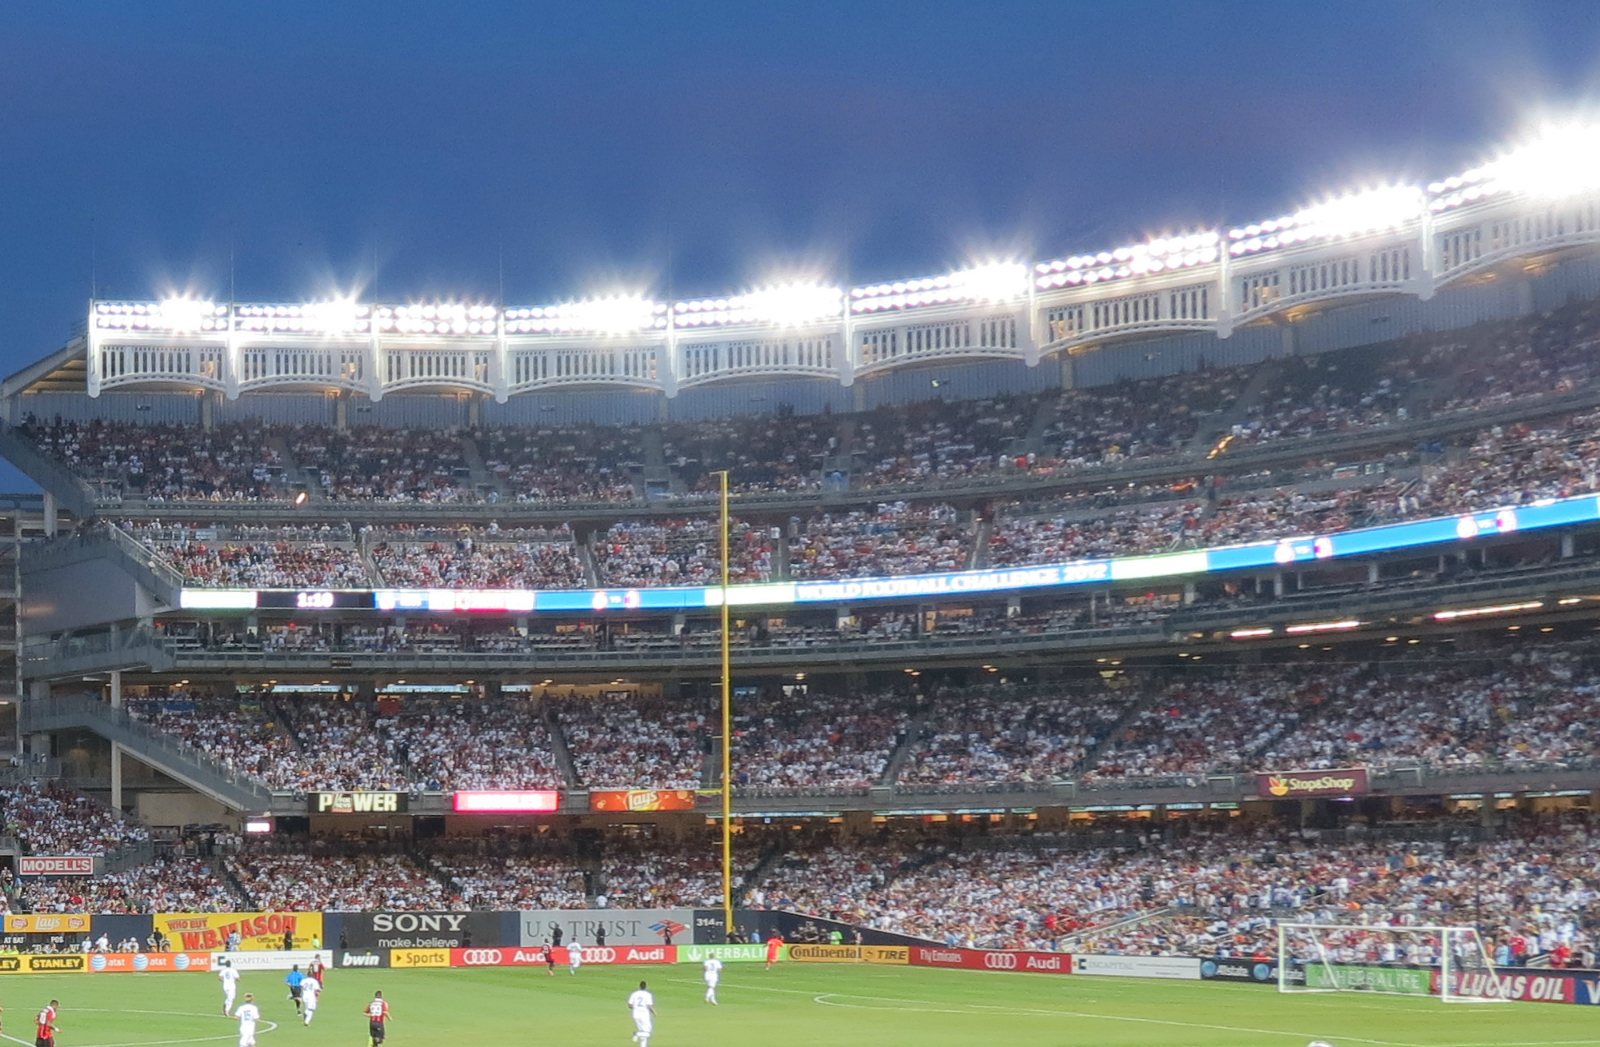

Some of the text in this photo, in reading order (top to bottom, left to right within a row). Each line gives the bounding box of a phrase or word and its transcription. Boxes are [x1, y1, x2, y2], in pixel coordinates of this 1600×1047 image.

[23, 860, 92, 872] MODELL'S
[373, 913, 466, 932] SONY
[378, 937, 459, 949] make.believe
[343, 952, 379, 967] bwin
[406, 952, 445, 964] Sports
[626, 949, 665, 961] Audi
[789, 945, 907, 961] Continental TIRE
[920, 950, 932, 964] Fly
[32, 958, 81, 969] STANLEY
[1025, 956, 1061, 970] Audi
[1530, 976, 1565, 1000] OIL
